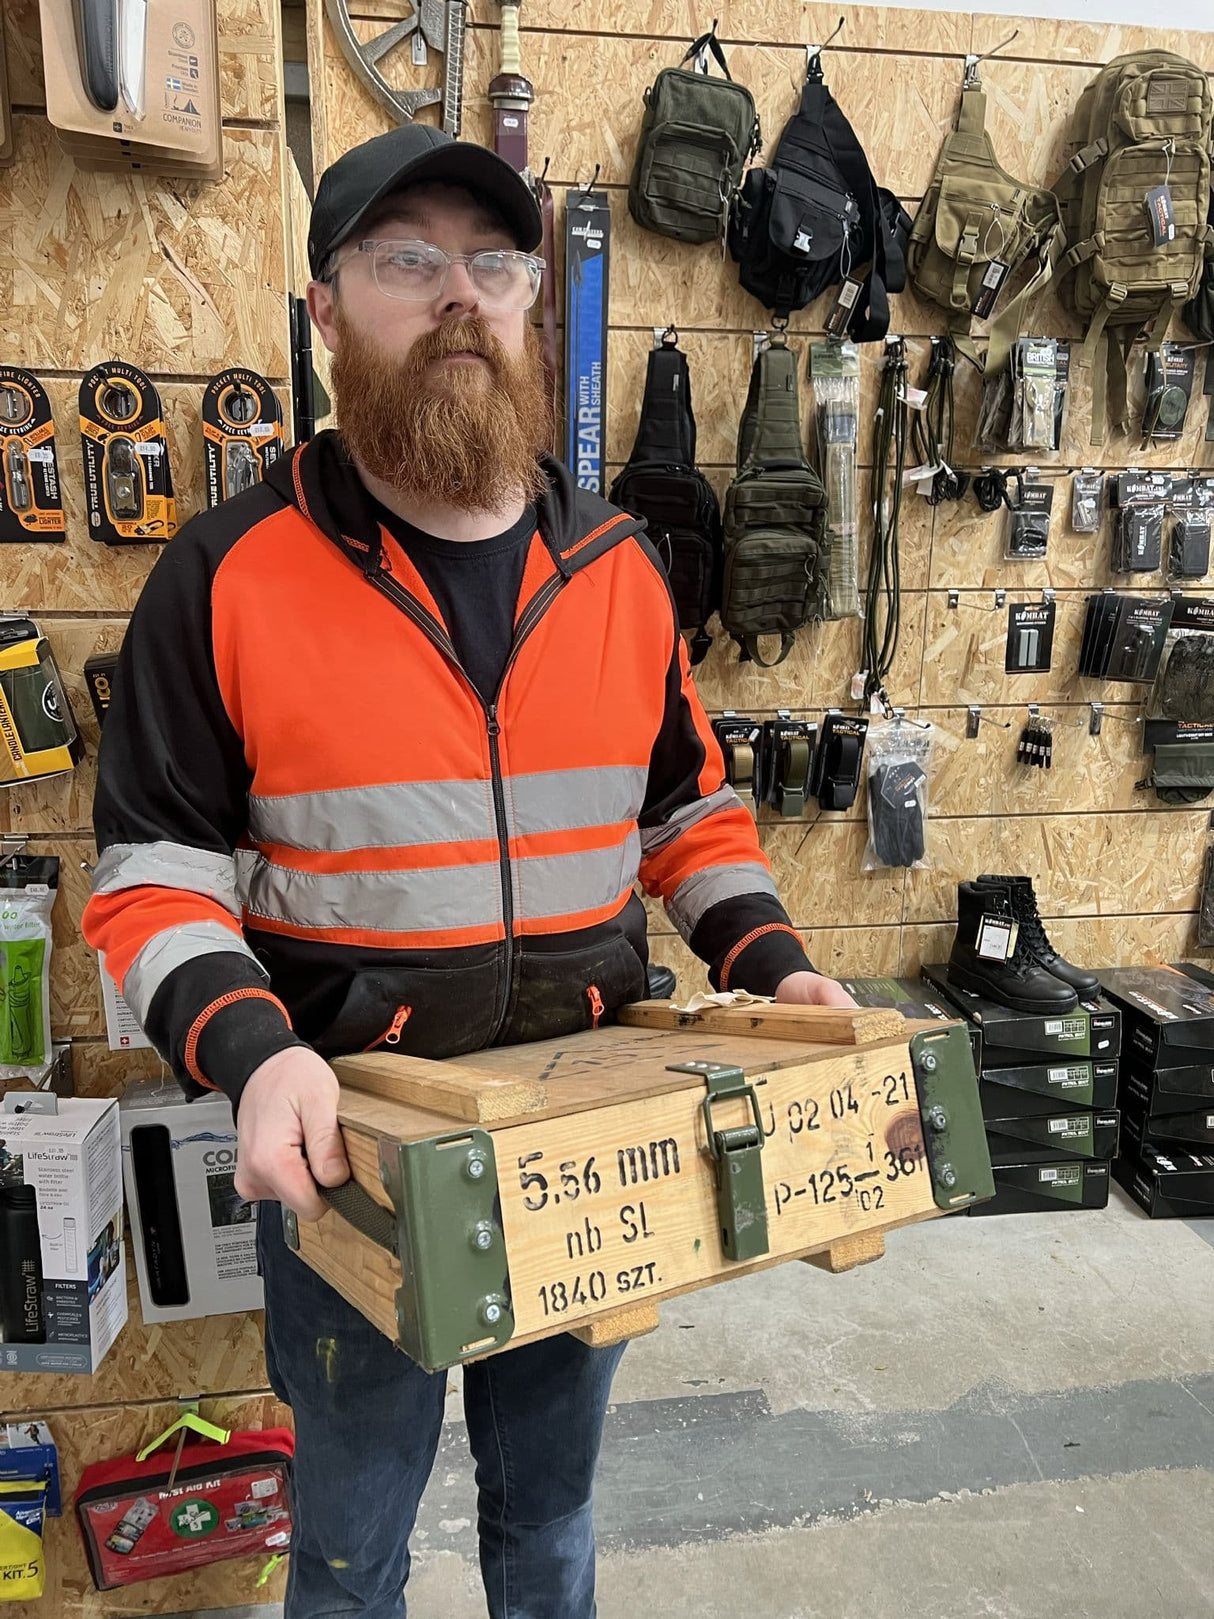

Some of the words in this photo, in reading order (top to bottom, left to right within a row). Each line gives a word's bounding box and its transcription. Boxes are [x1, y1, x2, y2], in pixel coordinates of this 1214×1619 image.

[163, 113, 201, 129] COMPANION
[1157, 197, 1168, 236] TACTICAL
[1026, 351, 1055, 364] BRITISH
[17, 372, 41, 398] LIGHTER
[88, 368, 108, 388] POCT
[111, 367, 132, 377] MULTI
[133, 374, 147, 390] TOOL
[211, 375, 231, 395] POCKET
[233, 373, 252, 382] MULTI
[254, 380, 267, 395] TOOL
[579, 375, 590, 405] WITH
[592, 362, 602, 406] SHEATH
[222, 423, 235, 435] FREE
[85, 440, 98, 481] UTILITY
[207, 443, 217, 485] UTILITY
[577, 406, 601, 494] SPEAR
[90, 482, 99, 510] TRUE
[1015, 611, 1050, 621] KOMBAT
[1134, 609, 1160, 617] KOMBAT
[1187, 606, 1214, 616] KOMBA
[5, 732, 23, 761] CANDLE
[830, 1085, 859, 1119] 04
[27, 1151, 68, 1161] LifeStraw
[517, 1151, 601, 1212] 5.56
[617, 1137, 681, 1187] mm
[566, 1217, 602, 1259] nb
[620, 1202, 655, 1244] SL
[24, 1275, 39, 1333] LifeStraw
[538, 1270, 607, 1316] 1840
[186, 1482, 203, 1493] Aid
[205, 1479, 221, 1489] Kit
